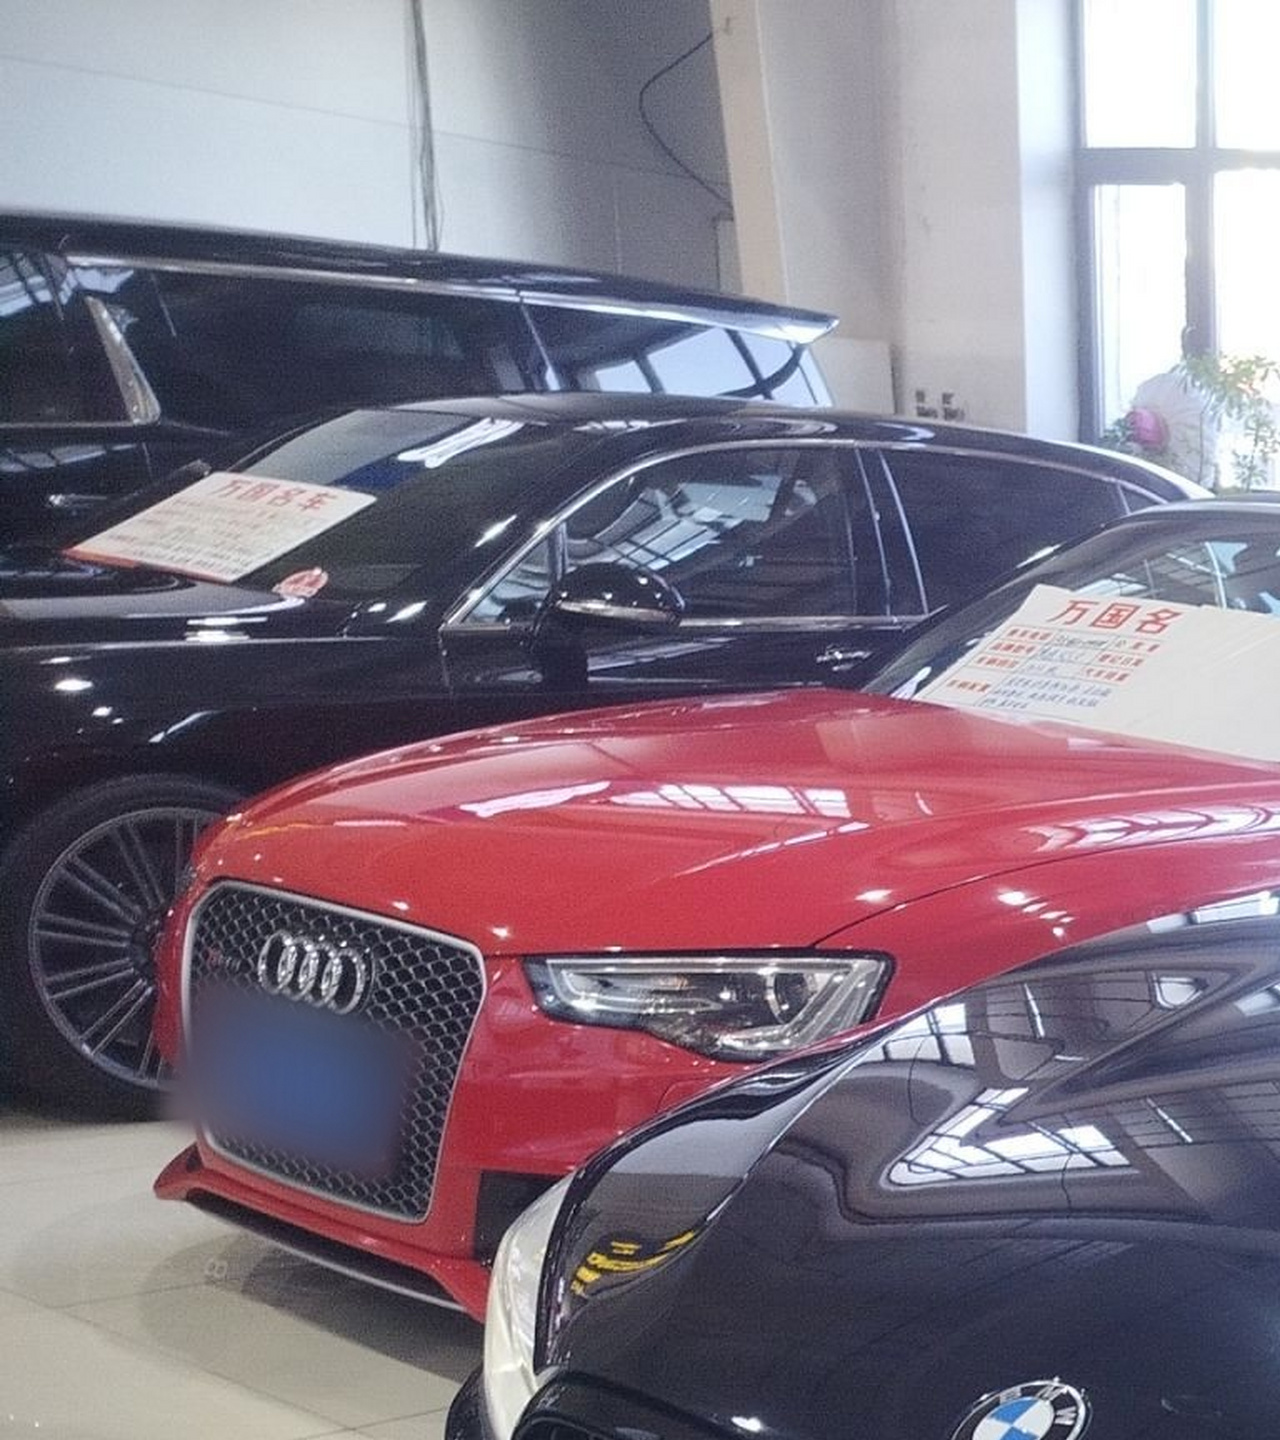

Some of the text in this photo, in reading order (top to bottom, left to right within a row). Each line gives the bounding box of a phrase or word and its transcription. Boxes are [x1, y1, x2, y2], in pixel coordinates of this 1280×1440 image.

[1048, 600, 1182, 634] 万国名
[998, 1384, 1077, 1426] BMW
